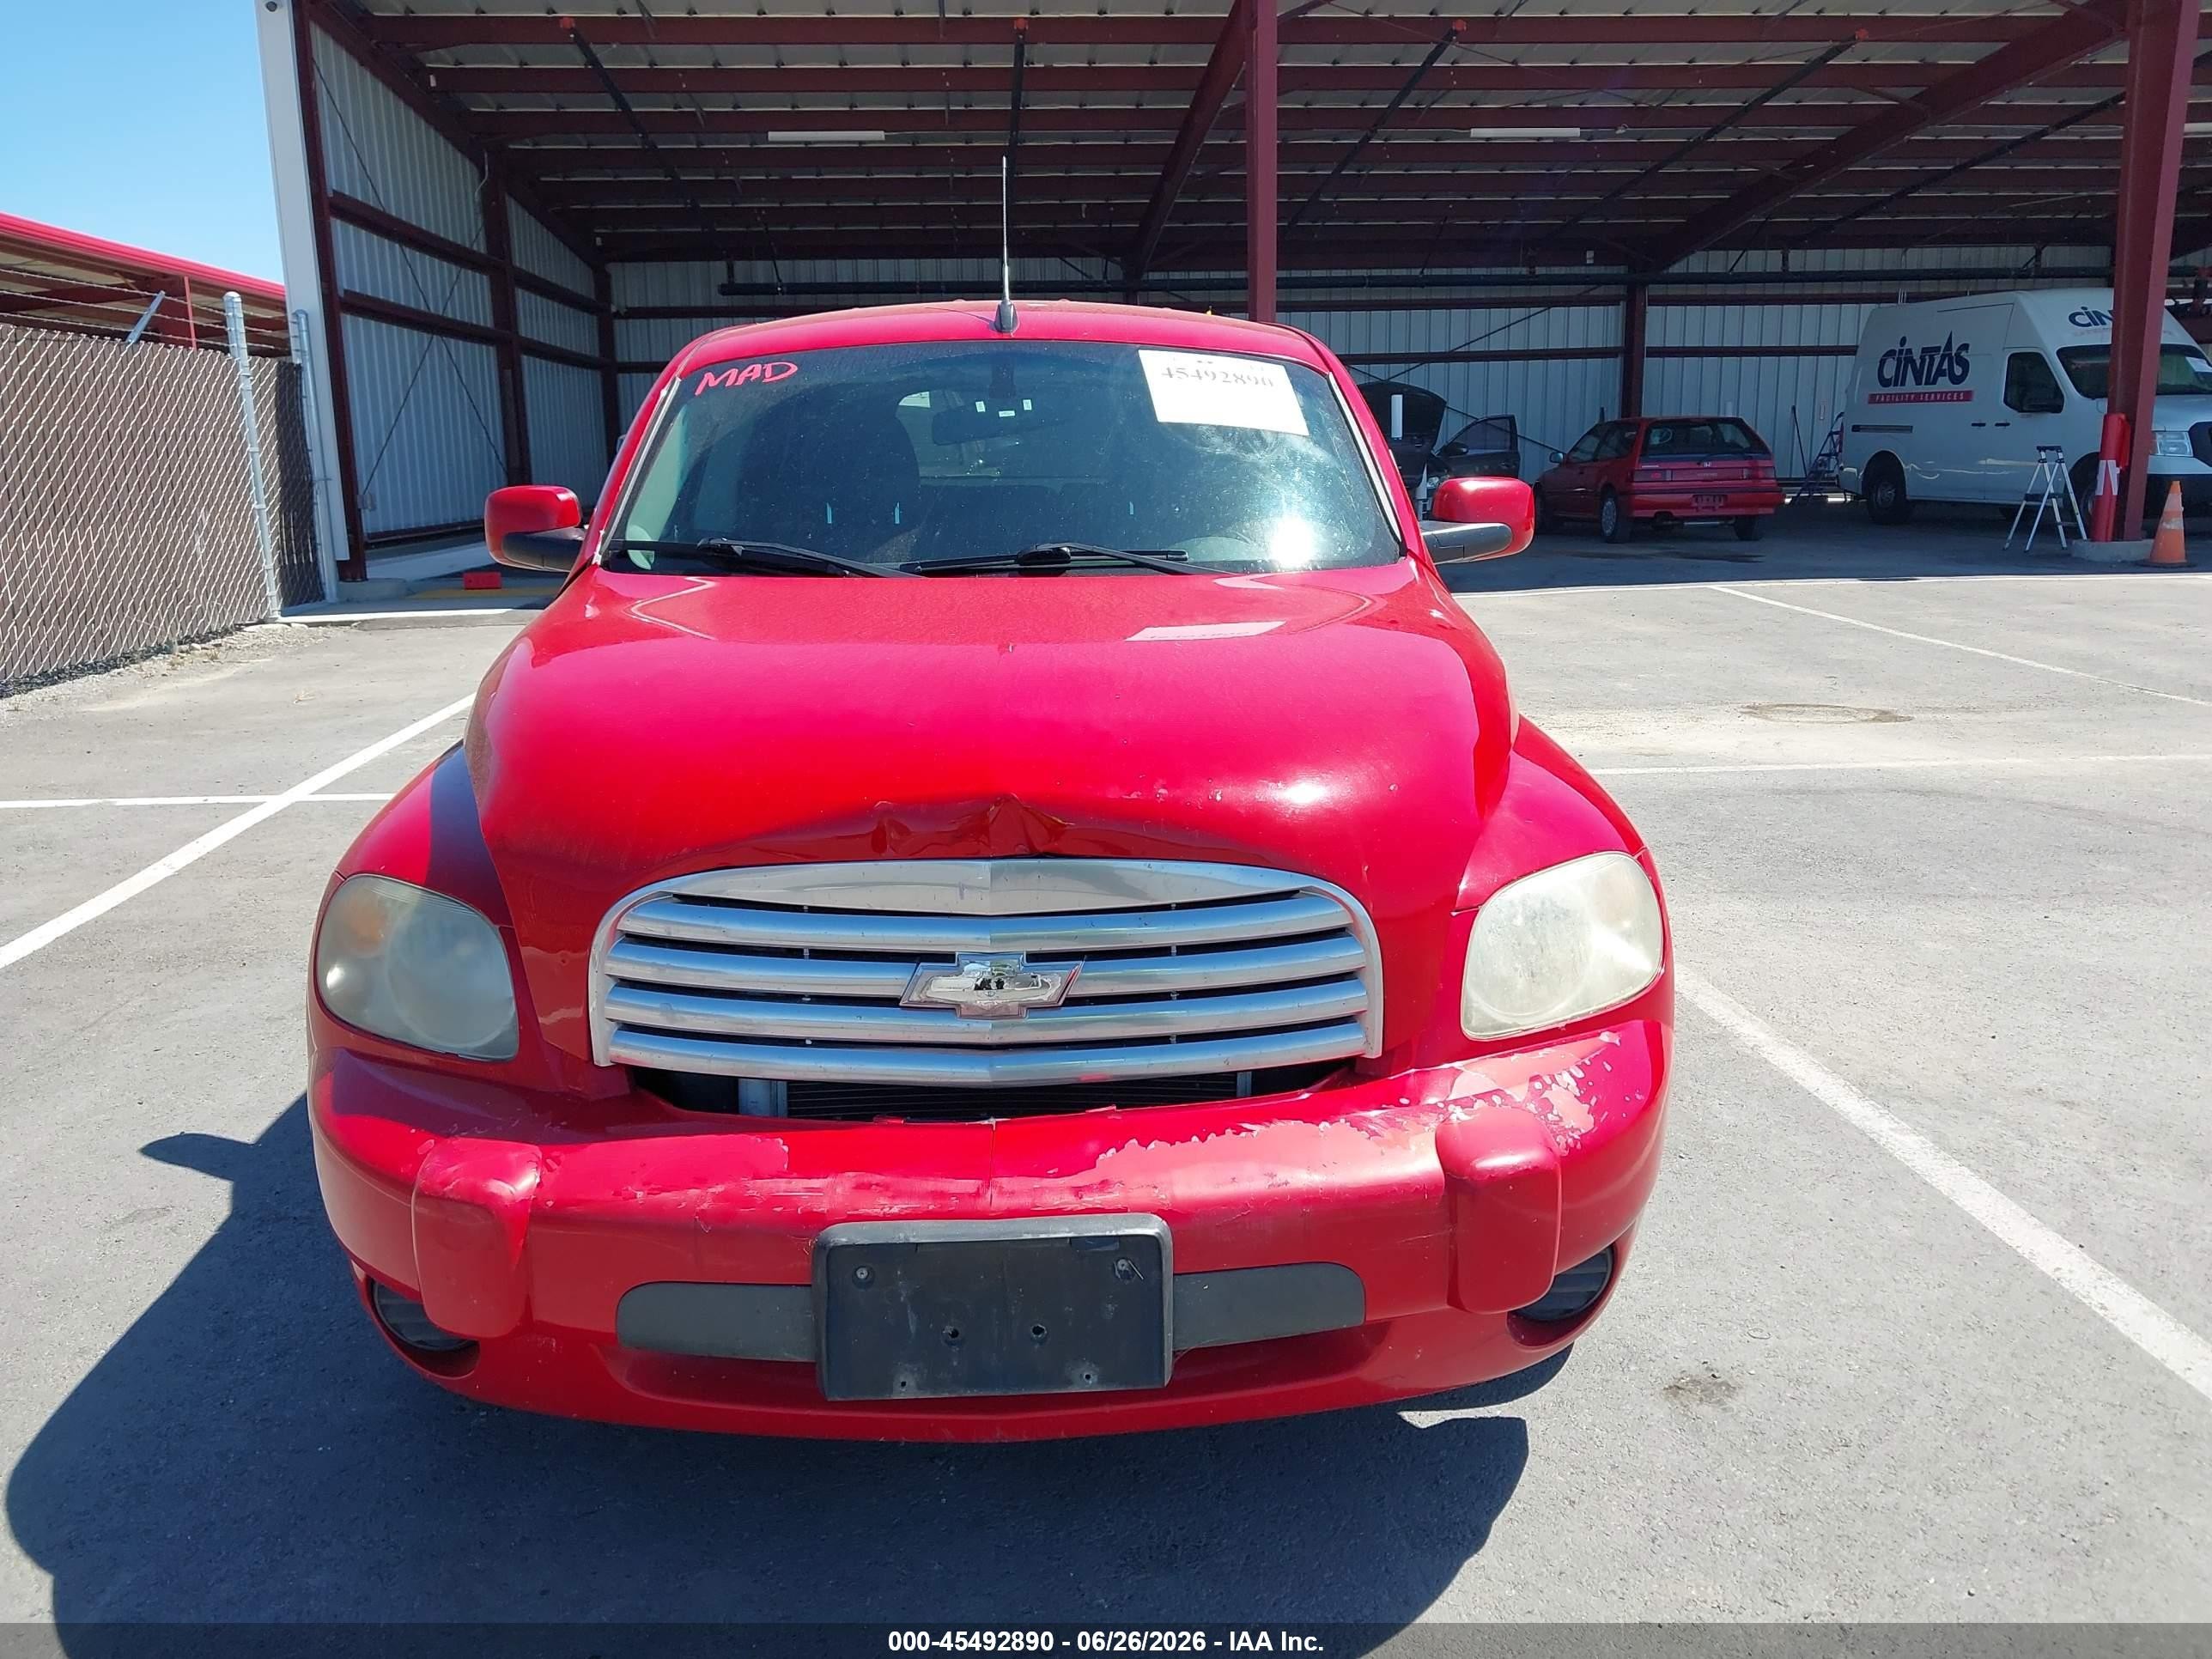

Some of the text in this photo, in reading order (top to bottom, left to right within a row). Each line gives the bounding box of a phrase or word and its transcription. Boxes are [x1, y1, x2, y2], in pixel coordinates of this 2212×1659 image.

[694, 361, 799, 397] MAD
[1161, 367, 1274, 388] 45492890
[1875, 392, 1965, 403] FACILITY SERVICES
